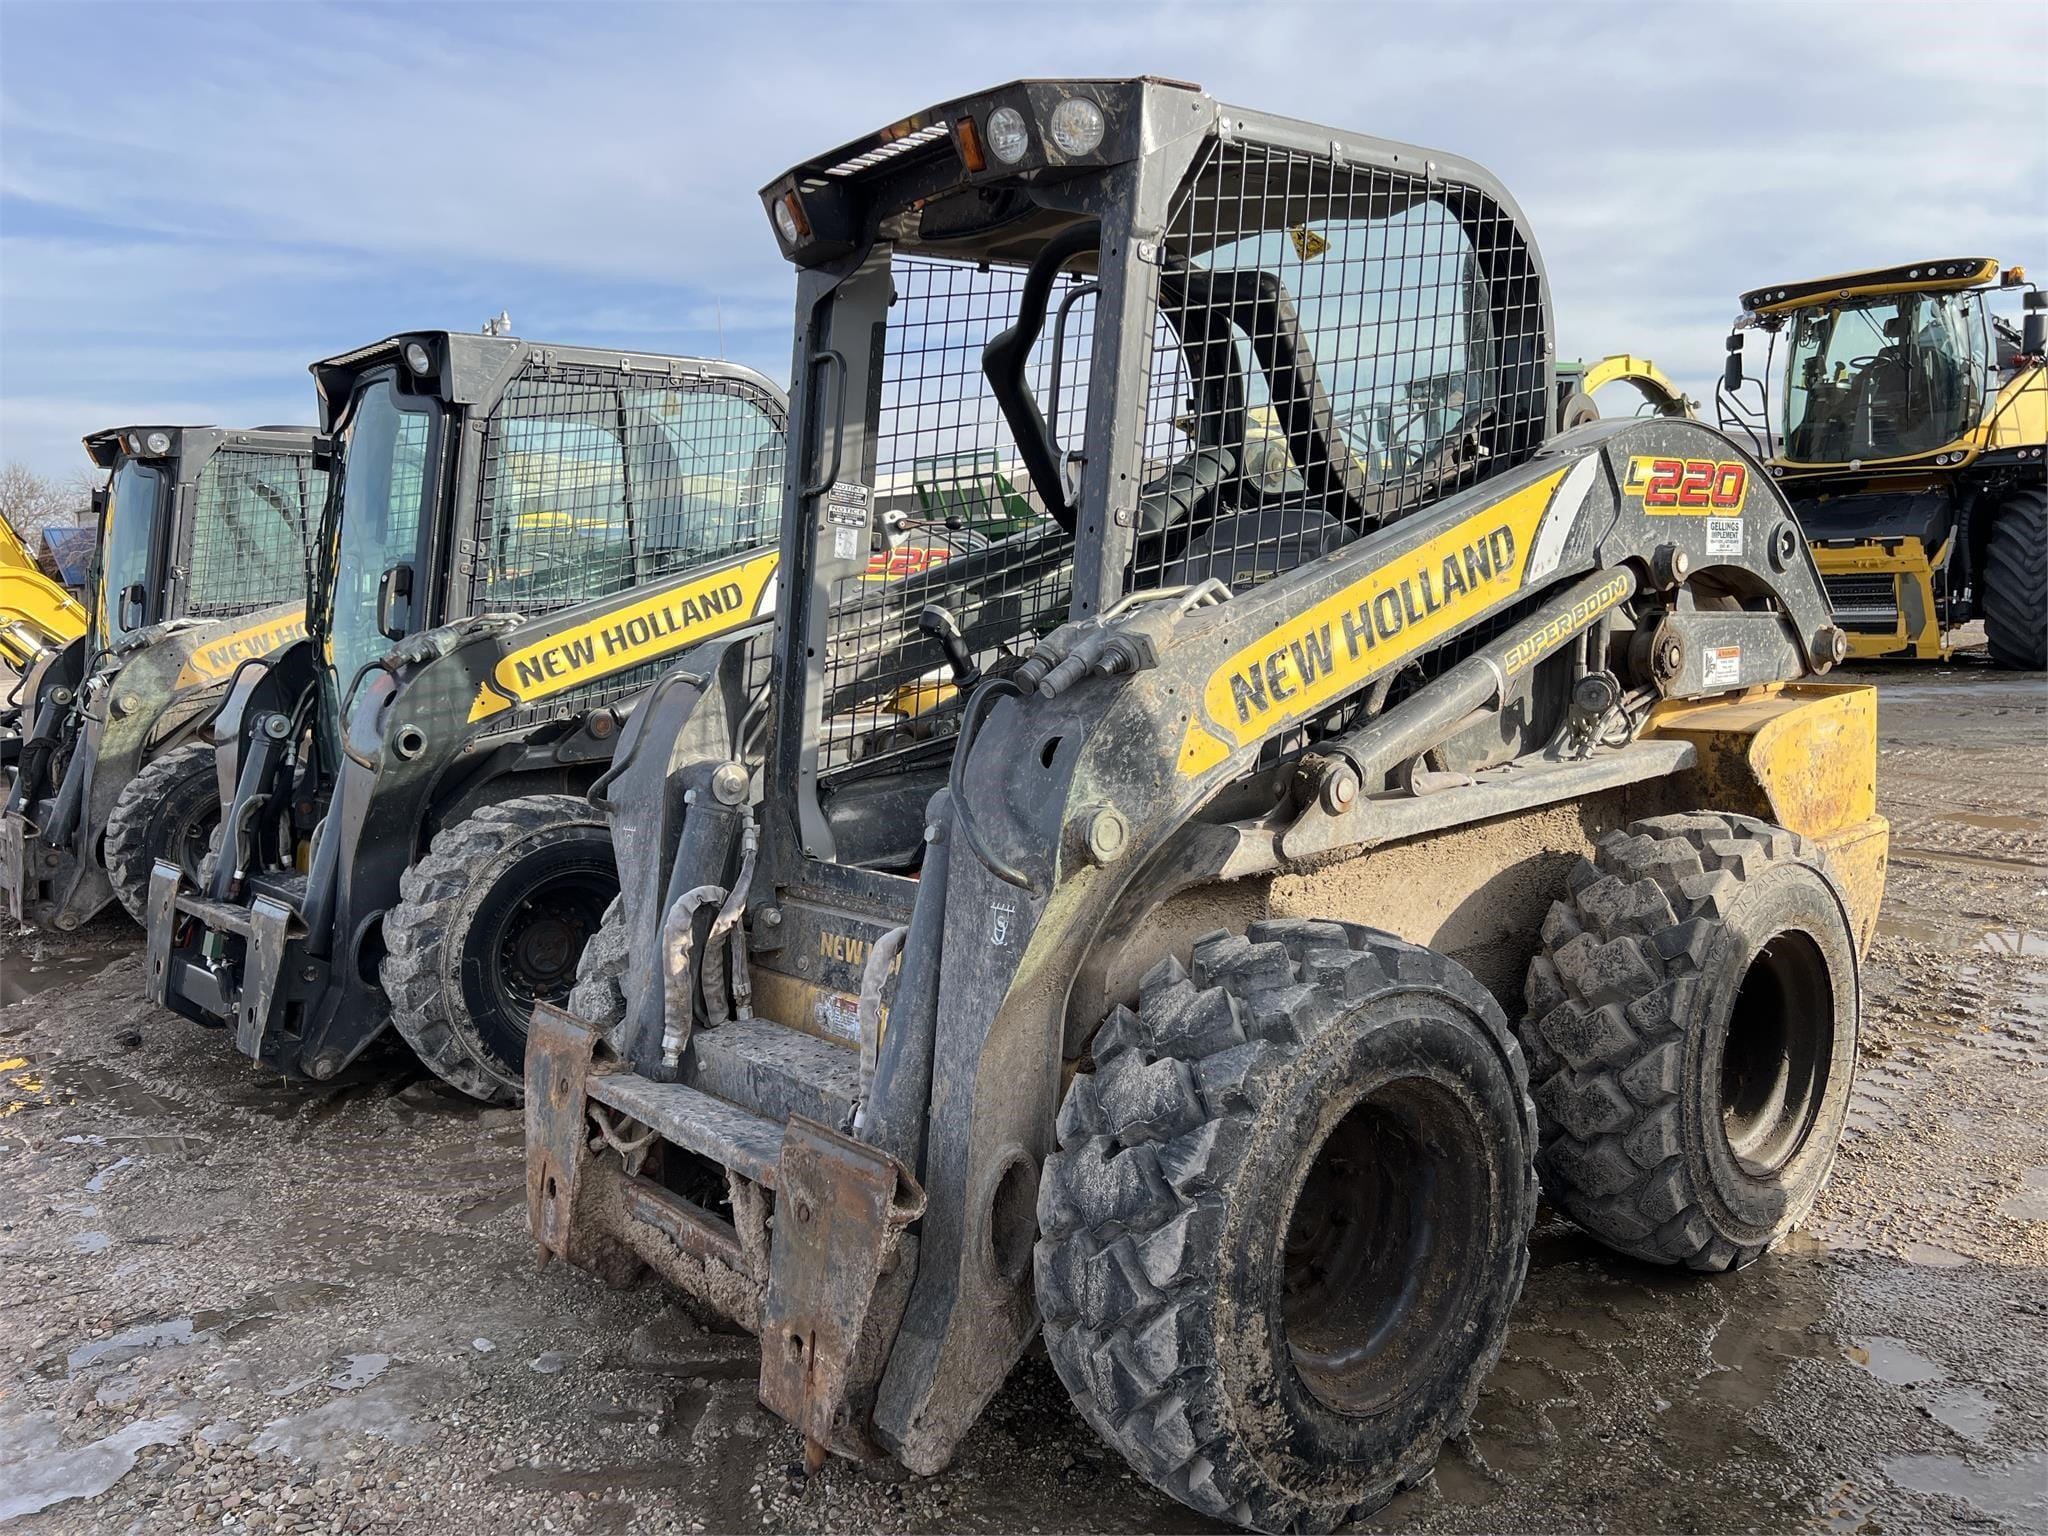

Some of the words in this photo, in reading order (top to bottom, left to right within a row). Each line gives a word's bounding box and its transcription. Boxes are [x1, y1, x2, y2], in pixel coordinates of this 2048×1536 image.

[834, 483, 863, 493] NOTICE
[1625, 459, 1747, 511] L220
[831, 505, 864, 515] NOTICE
[1710, 521, 1739, 532] GELLINGS
[515, 636, 595, 688] NEW
[601, 583, 743, 656] HOLLAND
[1228, 623, 1335, 726] NEW
[1340, 524, 1517, 662] HOLLAND
[207, 632, 270, 668] NEW
[820, 931, 864, 966] NEW
